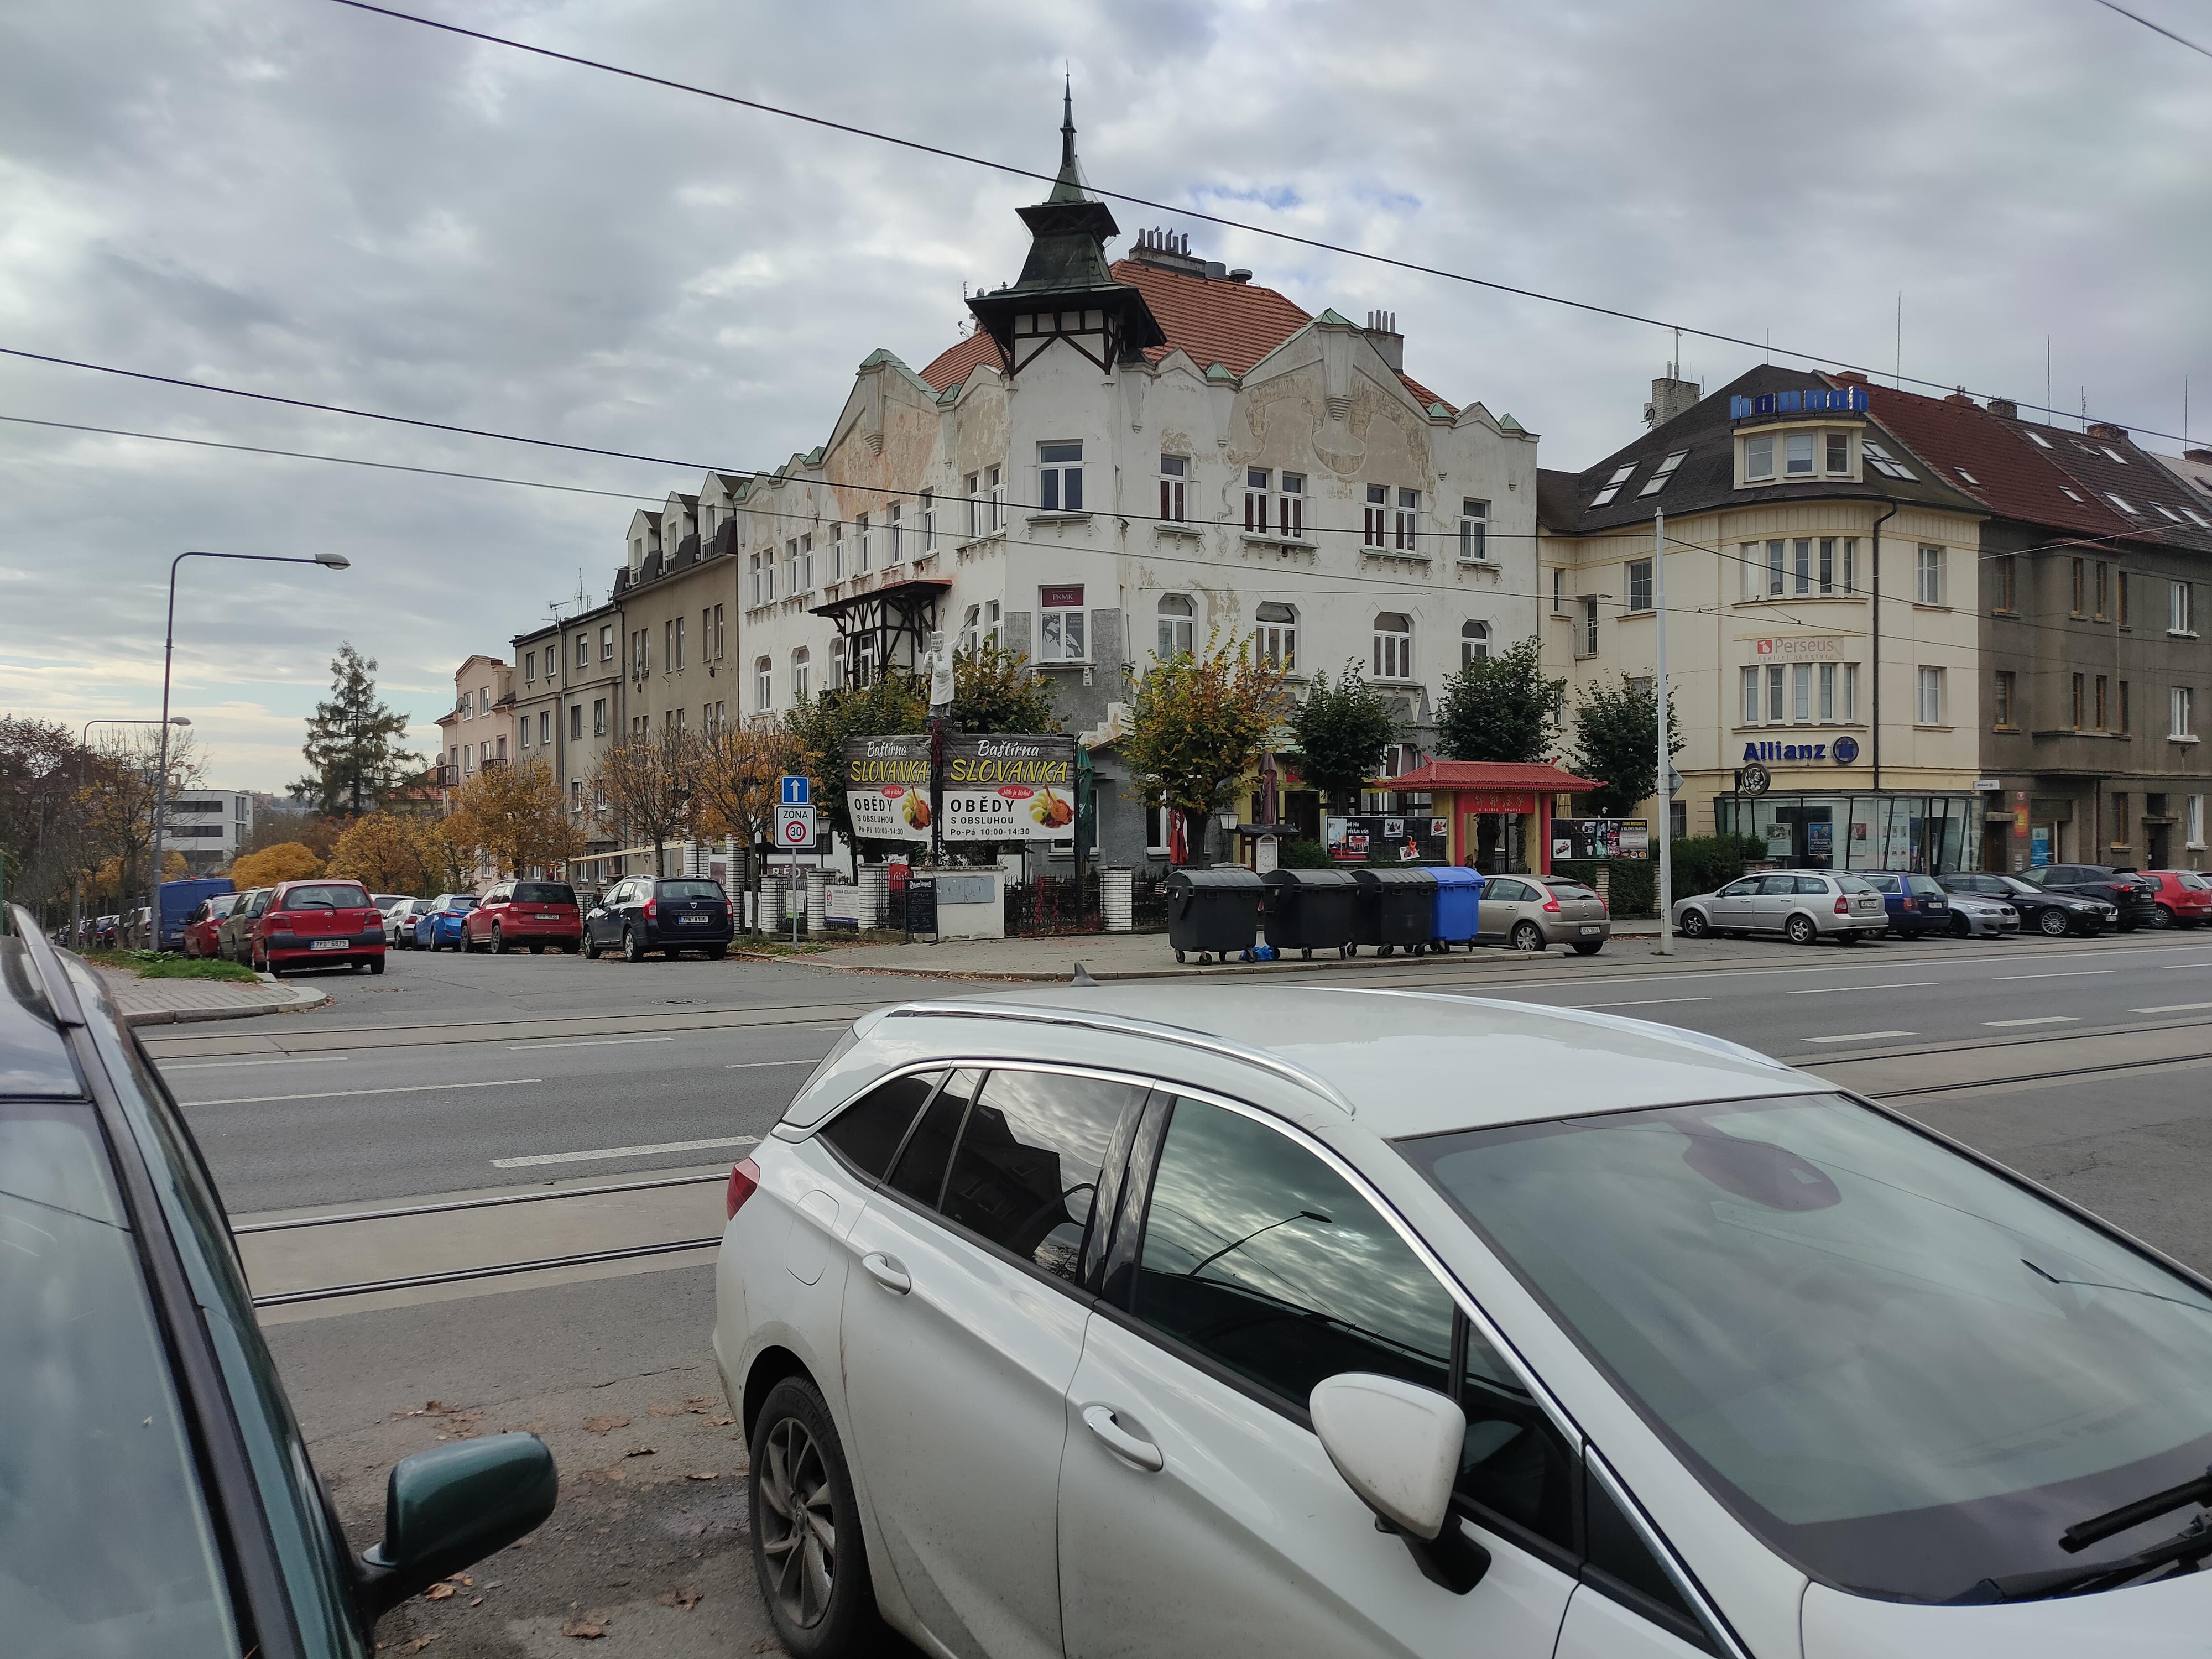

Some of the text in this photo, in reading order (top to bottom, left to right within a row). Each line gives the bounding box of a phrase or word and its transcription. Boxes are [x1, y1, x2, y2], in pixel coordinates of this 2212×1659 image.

[1775, 639, 1834, 653] Perseus
[867, 740, 907, 758] Baštírna
[978, 739, 1040, 758] Baštírna
[1743, 741, 1827, 761] Allianz
[851, 760, 927, 782] SLOVANKA
[950, 759, 1068, 783] SLOVANKA
[854, 796, 893, 812] OBĚDY
[950, 796, 1015, 812] OBĚDY
[783, 808, 808, 818] ZÓNA
[863, 815, 893, 823] OBSLUHOU
[790, 827, 802, 836] 30
[874, 827, 904, 835] 10:00-14:30
